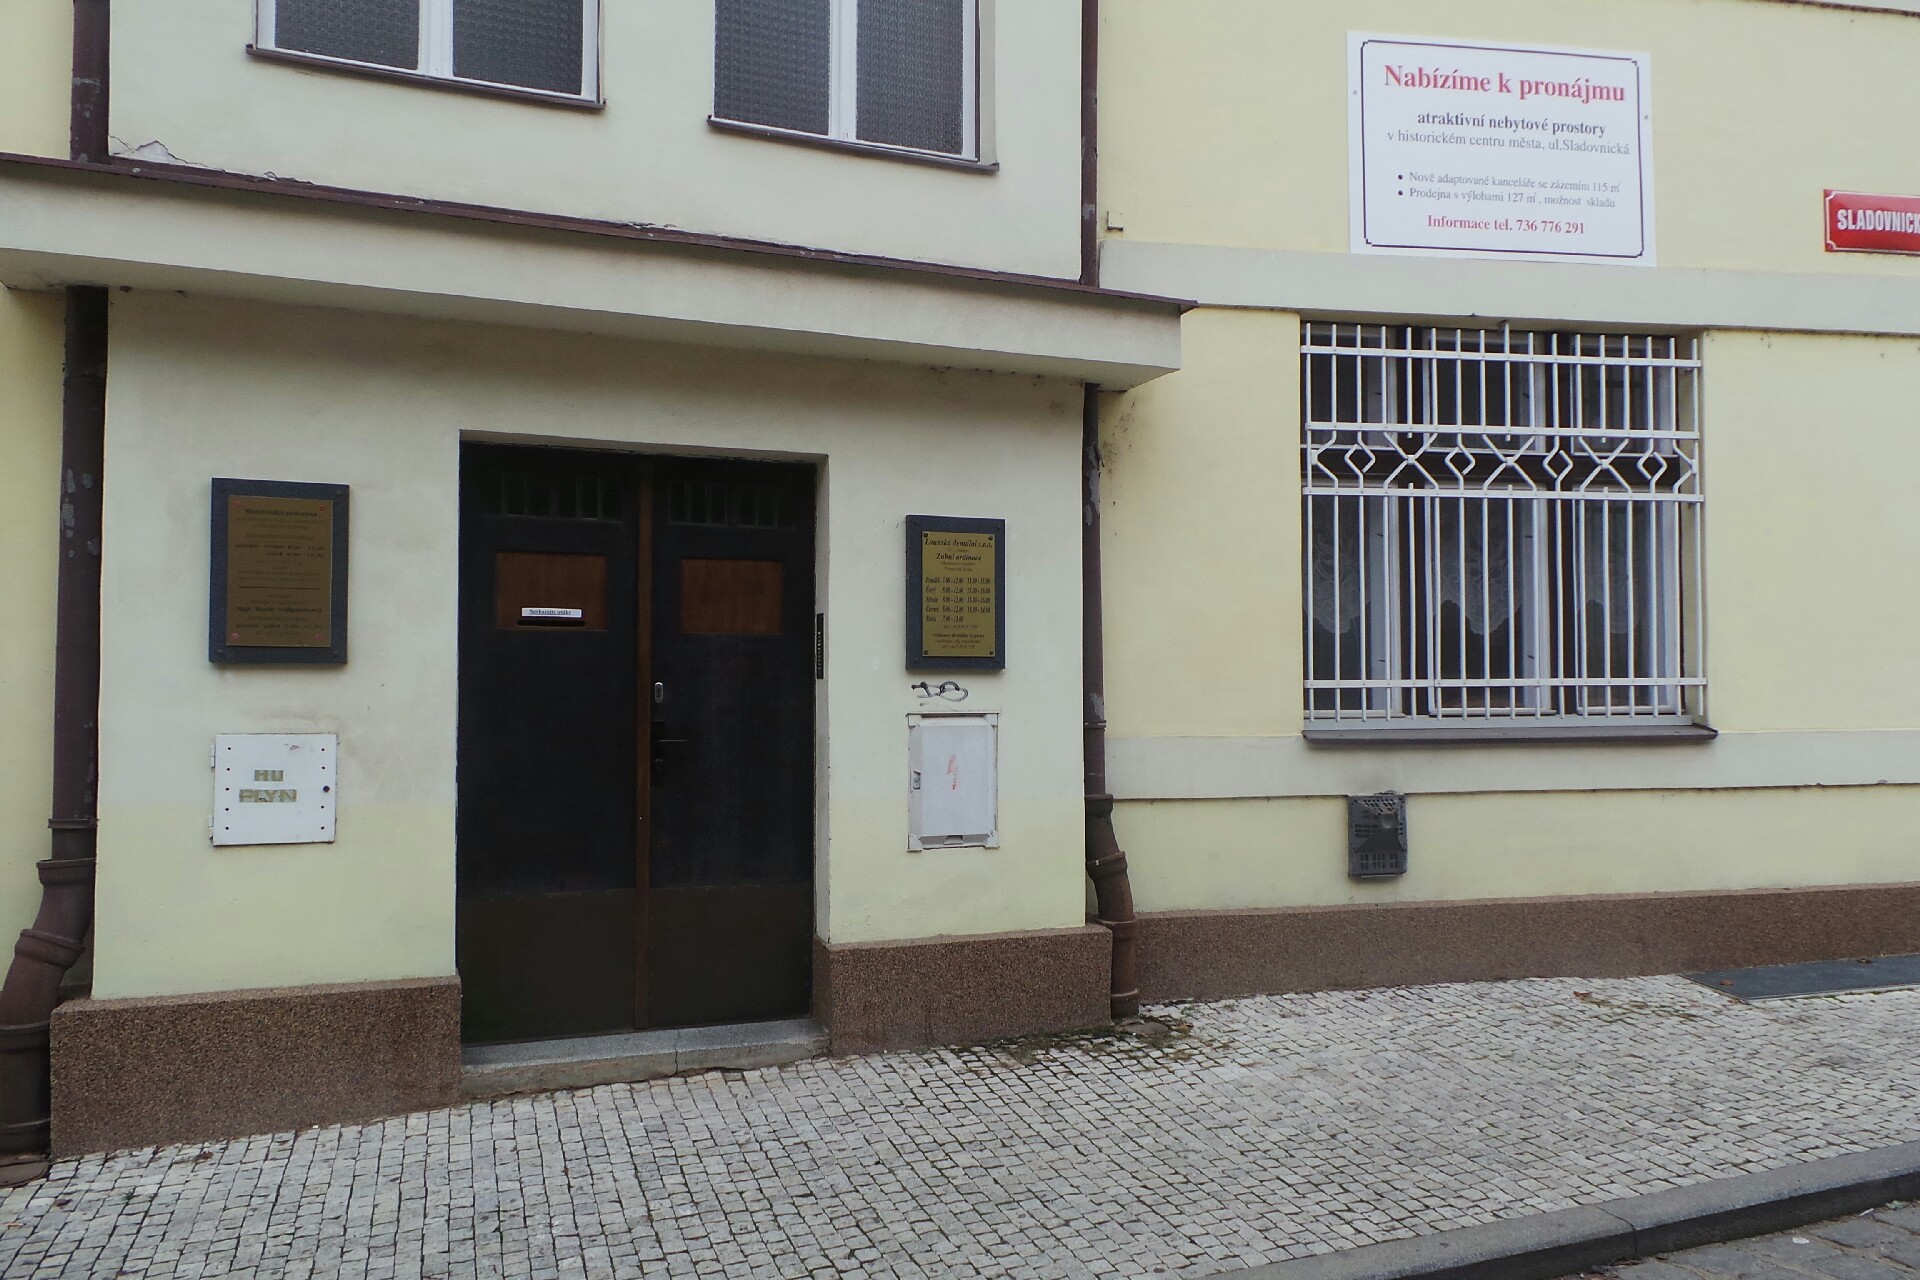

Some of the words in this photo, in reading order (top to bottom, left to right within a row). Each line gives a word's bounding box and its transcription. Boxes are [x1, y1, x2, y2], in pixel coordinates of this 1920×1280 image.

[1384, 65, 1490, 92] Nabízíme
[1498, 72, 1512, 93] k
[1518, 78, 1624, 104] pronájmu
[1417, 112, 1485, 128] atraktivní
[1489, 116, 1548, 132] nebytové
[1552, 120, 1606, 138] prostory
[1387, 132, 1394, 141] v
[1398, 130, 1466, 144] historickém
[1470, 136, 1504, 146] centru
[1509, 138, 1545, 151] města,
[1409, 172, 1434, 182] Nově
[1438, 174, 1489, 186] adaptované
[1492, 178, 1536, 188] kanceláře
[1550, 180, 1590, 190] zázemím
[1593, 182, 1608, 192] 115
[1410, 188, 1450, 200] Prodejna
[1462, 190, 1504, 202] výlohami
[1508, 193, 1524, 202] 127
[1544, 196, 1581, 206] možnost
[1586, 197, 1615, 208] skladu
[1428, 215, 1490, 230] Informace
[1494, 218, 1512, 230] tel.
[1516, 220, 1538, 232] 736
[1541, 221, 1562, 232] 776
[1565, 222, 1584, 234] 291
[240, 789, 297, 802] PLYN
